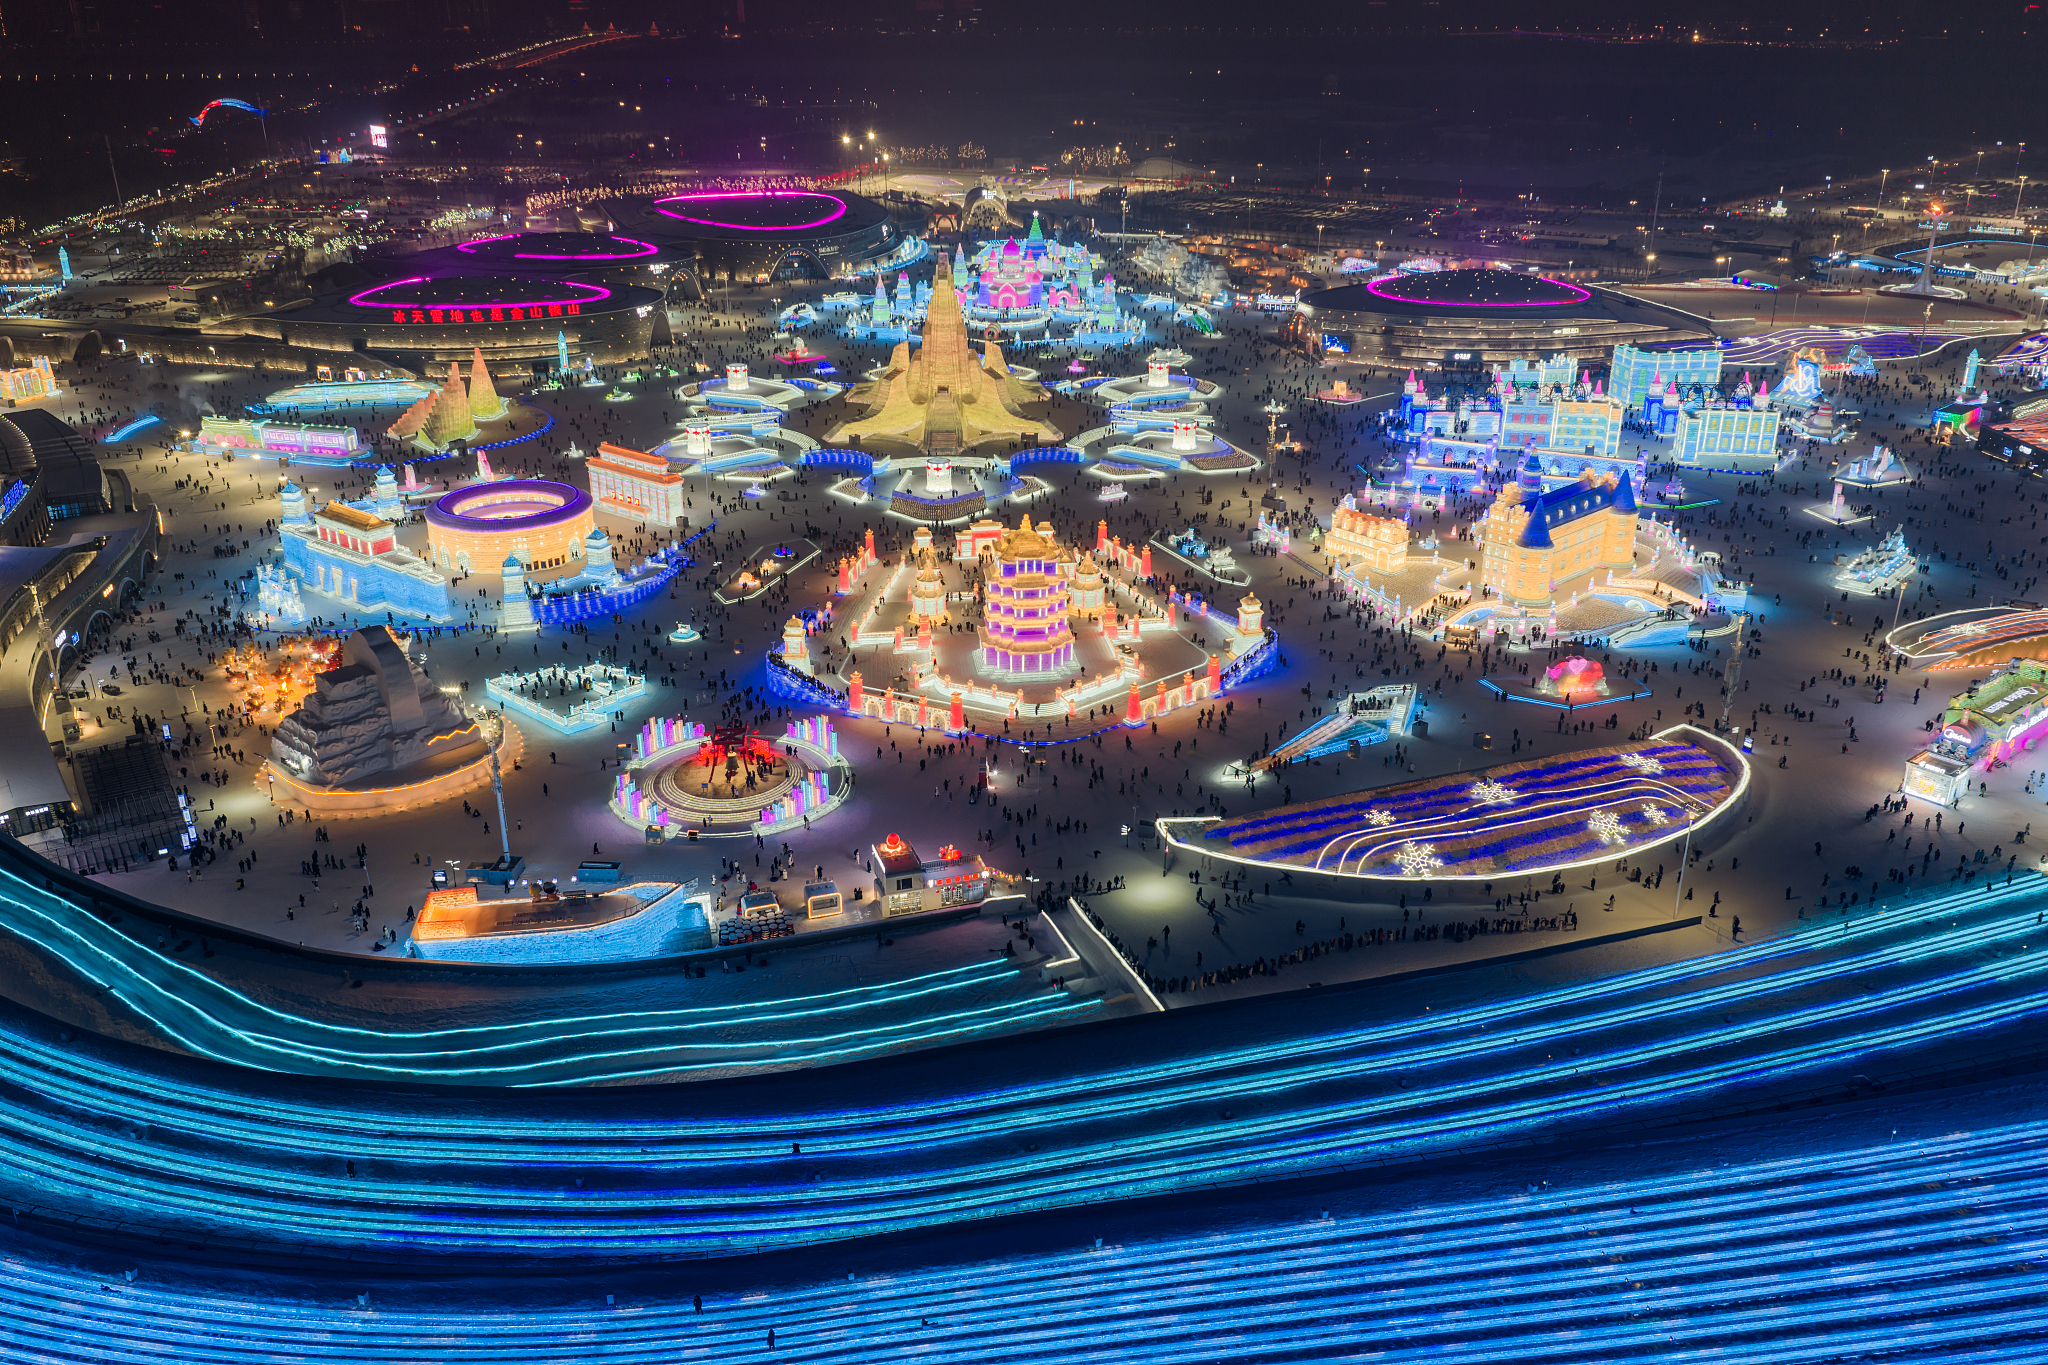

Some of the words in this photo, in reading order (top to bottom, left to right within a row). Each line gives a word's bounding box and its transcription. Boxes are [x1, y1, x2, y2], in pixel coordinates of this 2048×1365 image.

[392, 303, 581, 323] 冰天雪地也是金山银山
[1943, 728, 1971, 743] Midea
